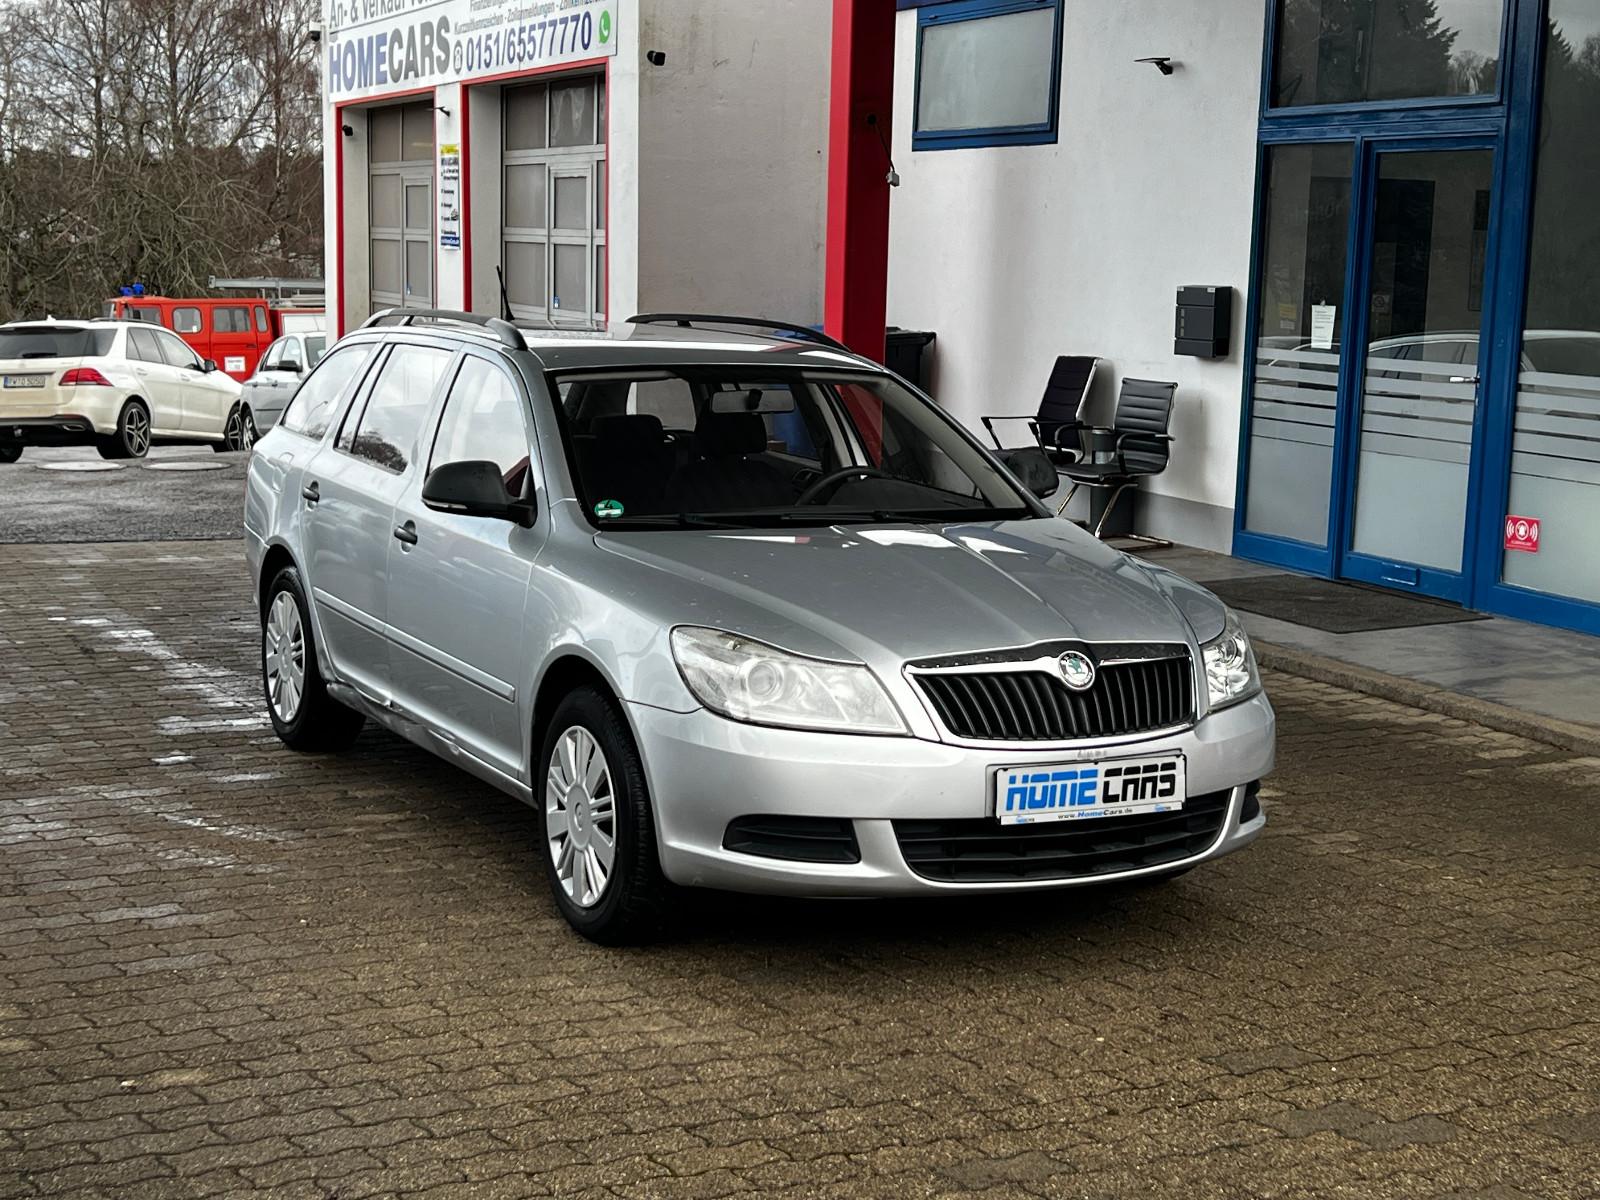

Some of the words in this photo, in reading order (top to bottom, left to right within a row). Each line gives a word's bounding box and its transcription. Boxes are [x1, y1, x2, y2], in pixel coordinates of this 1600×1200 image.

[329, 15, 450, 93] HOMECARS
[466, 11, 592, 72] 0151/65577770
[1006, 769, 1099, 811] HOME
[1102, 762, 1177, 804] CARS
